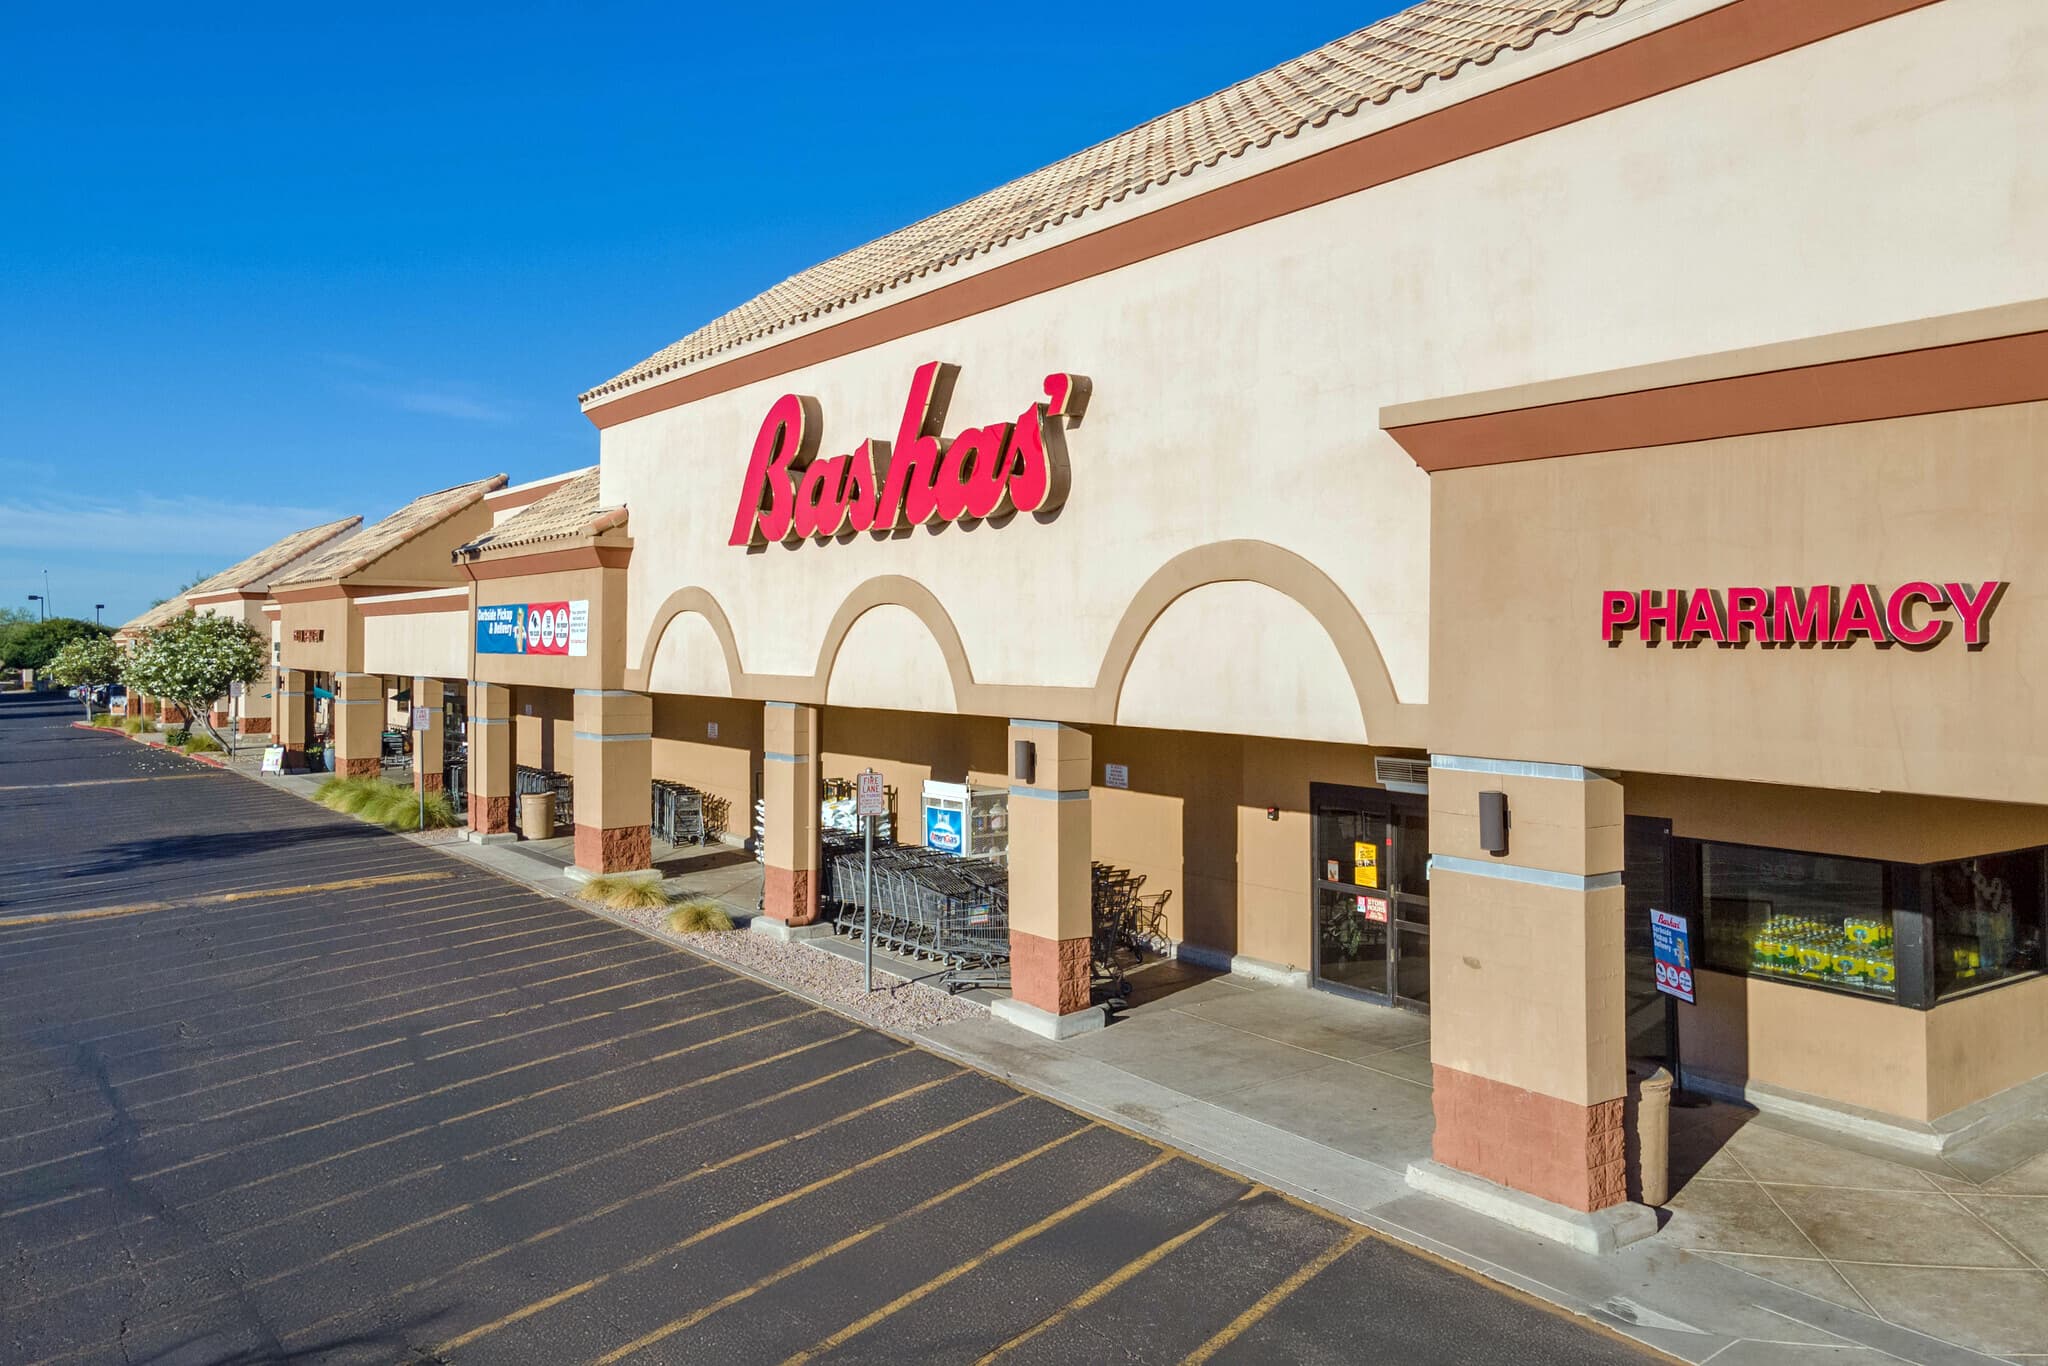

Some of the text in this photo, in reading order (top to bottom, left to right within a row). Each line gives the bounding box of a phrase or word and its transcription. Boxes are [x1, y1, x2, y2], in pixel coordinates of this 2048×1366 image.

[728, 361, 1073, 547] Bashas'
[497, 608, 513, 623] Pickup
[1601, 580, 2002, 646] PHARMACY
[863, 776, 879, 785] FIRE
[862, 785, 880, 793] LANE
